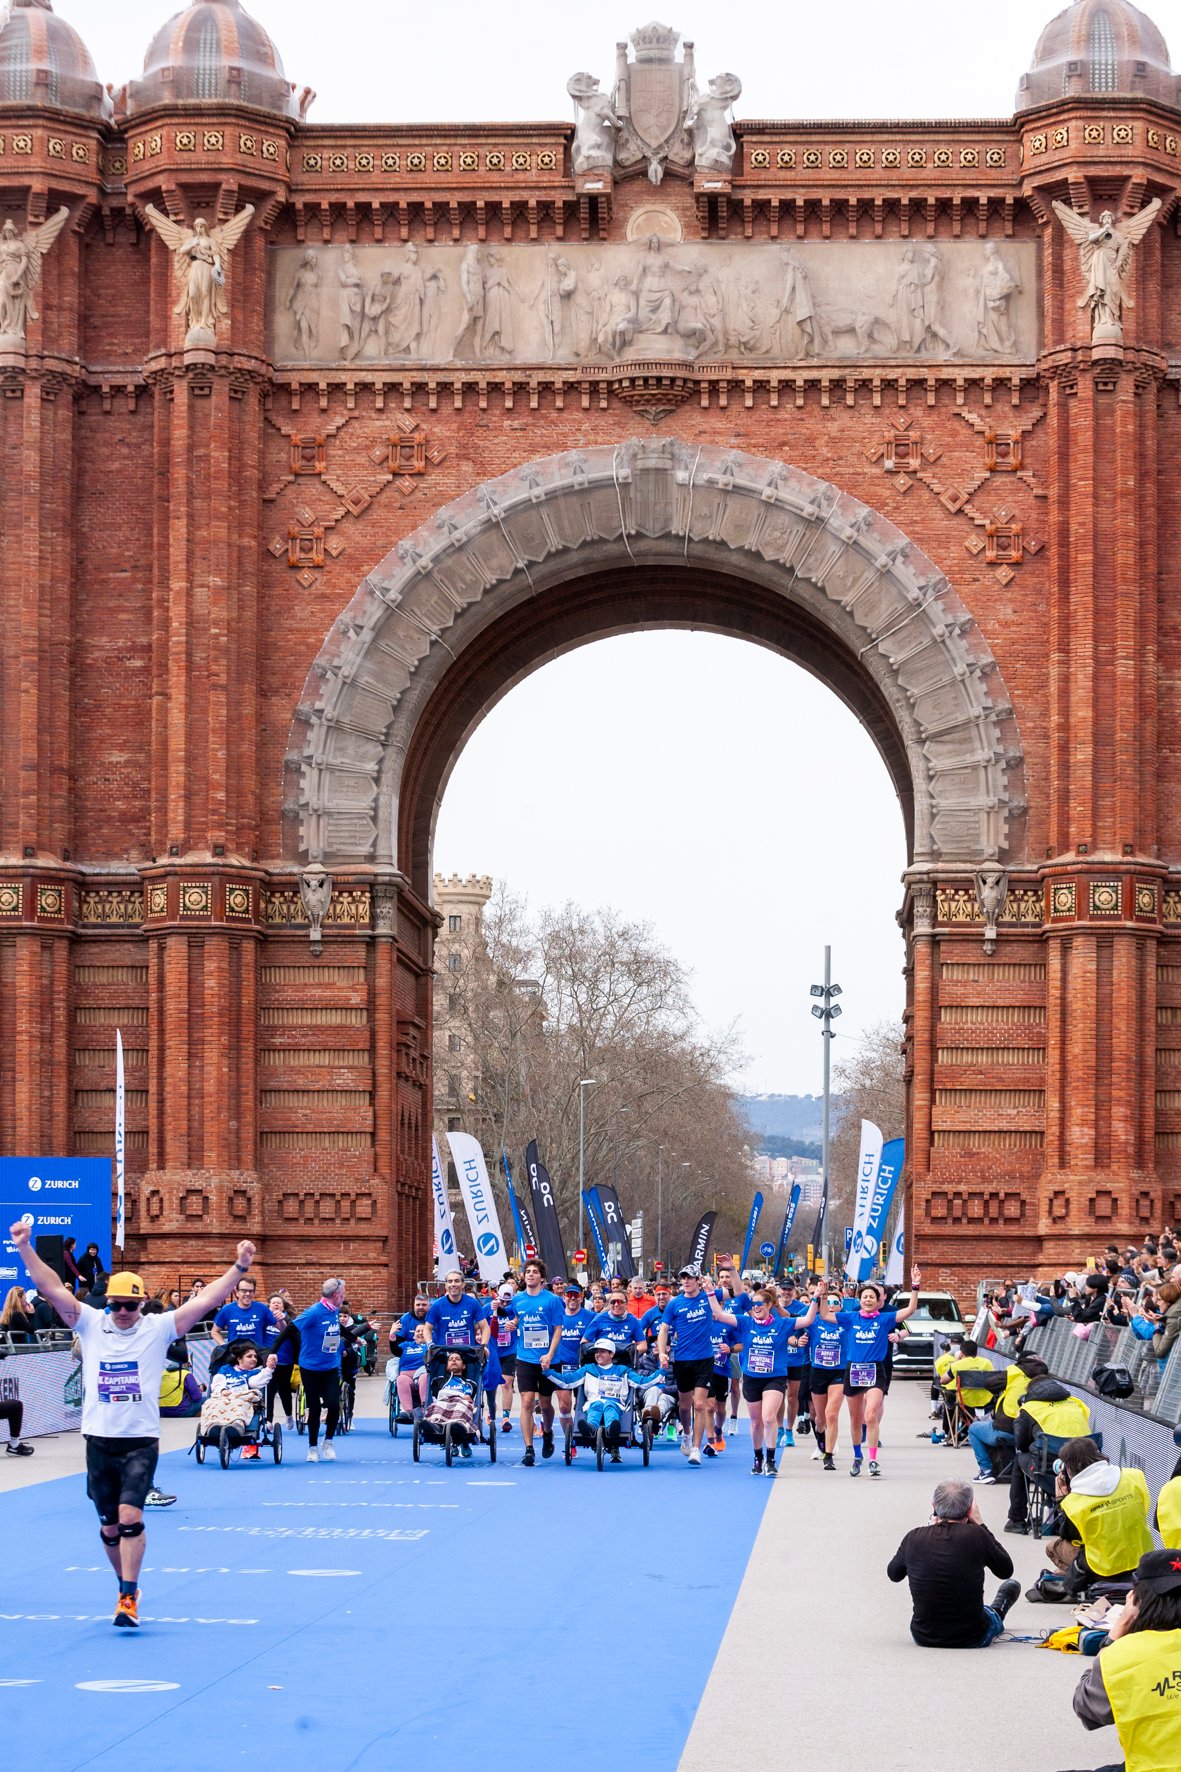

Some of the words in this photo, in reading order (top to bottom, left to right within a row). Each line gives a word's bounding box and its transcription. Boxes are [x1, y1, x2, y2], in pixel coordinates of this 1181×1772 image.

[45, 1180, 79, 1189] ZURICH
[867, 1164, 895, 1229] ZURICH
[37, 1216, 72, 1225] ZURICH
